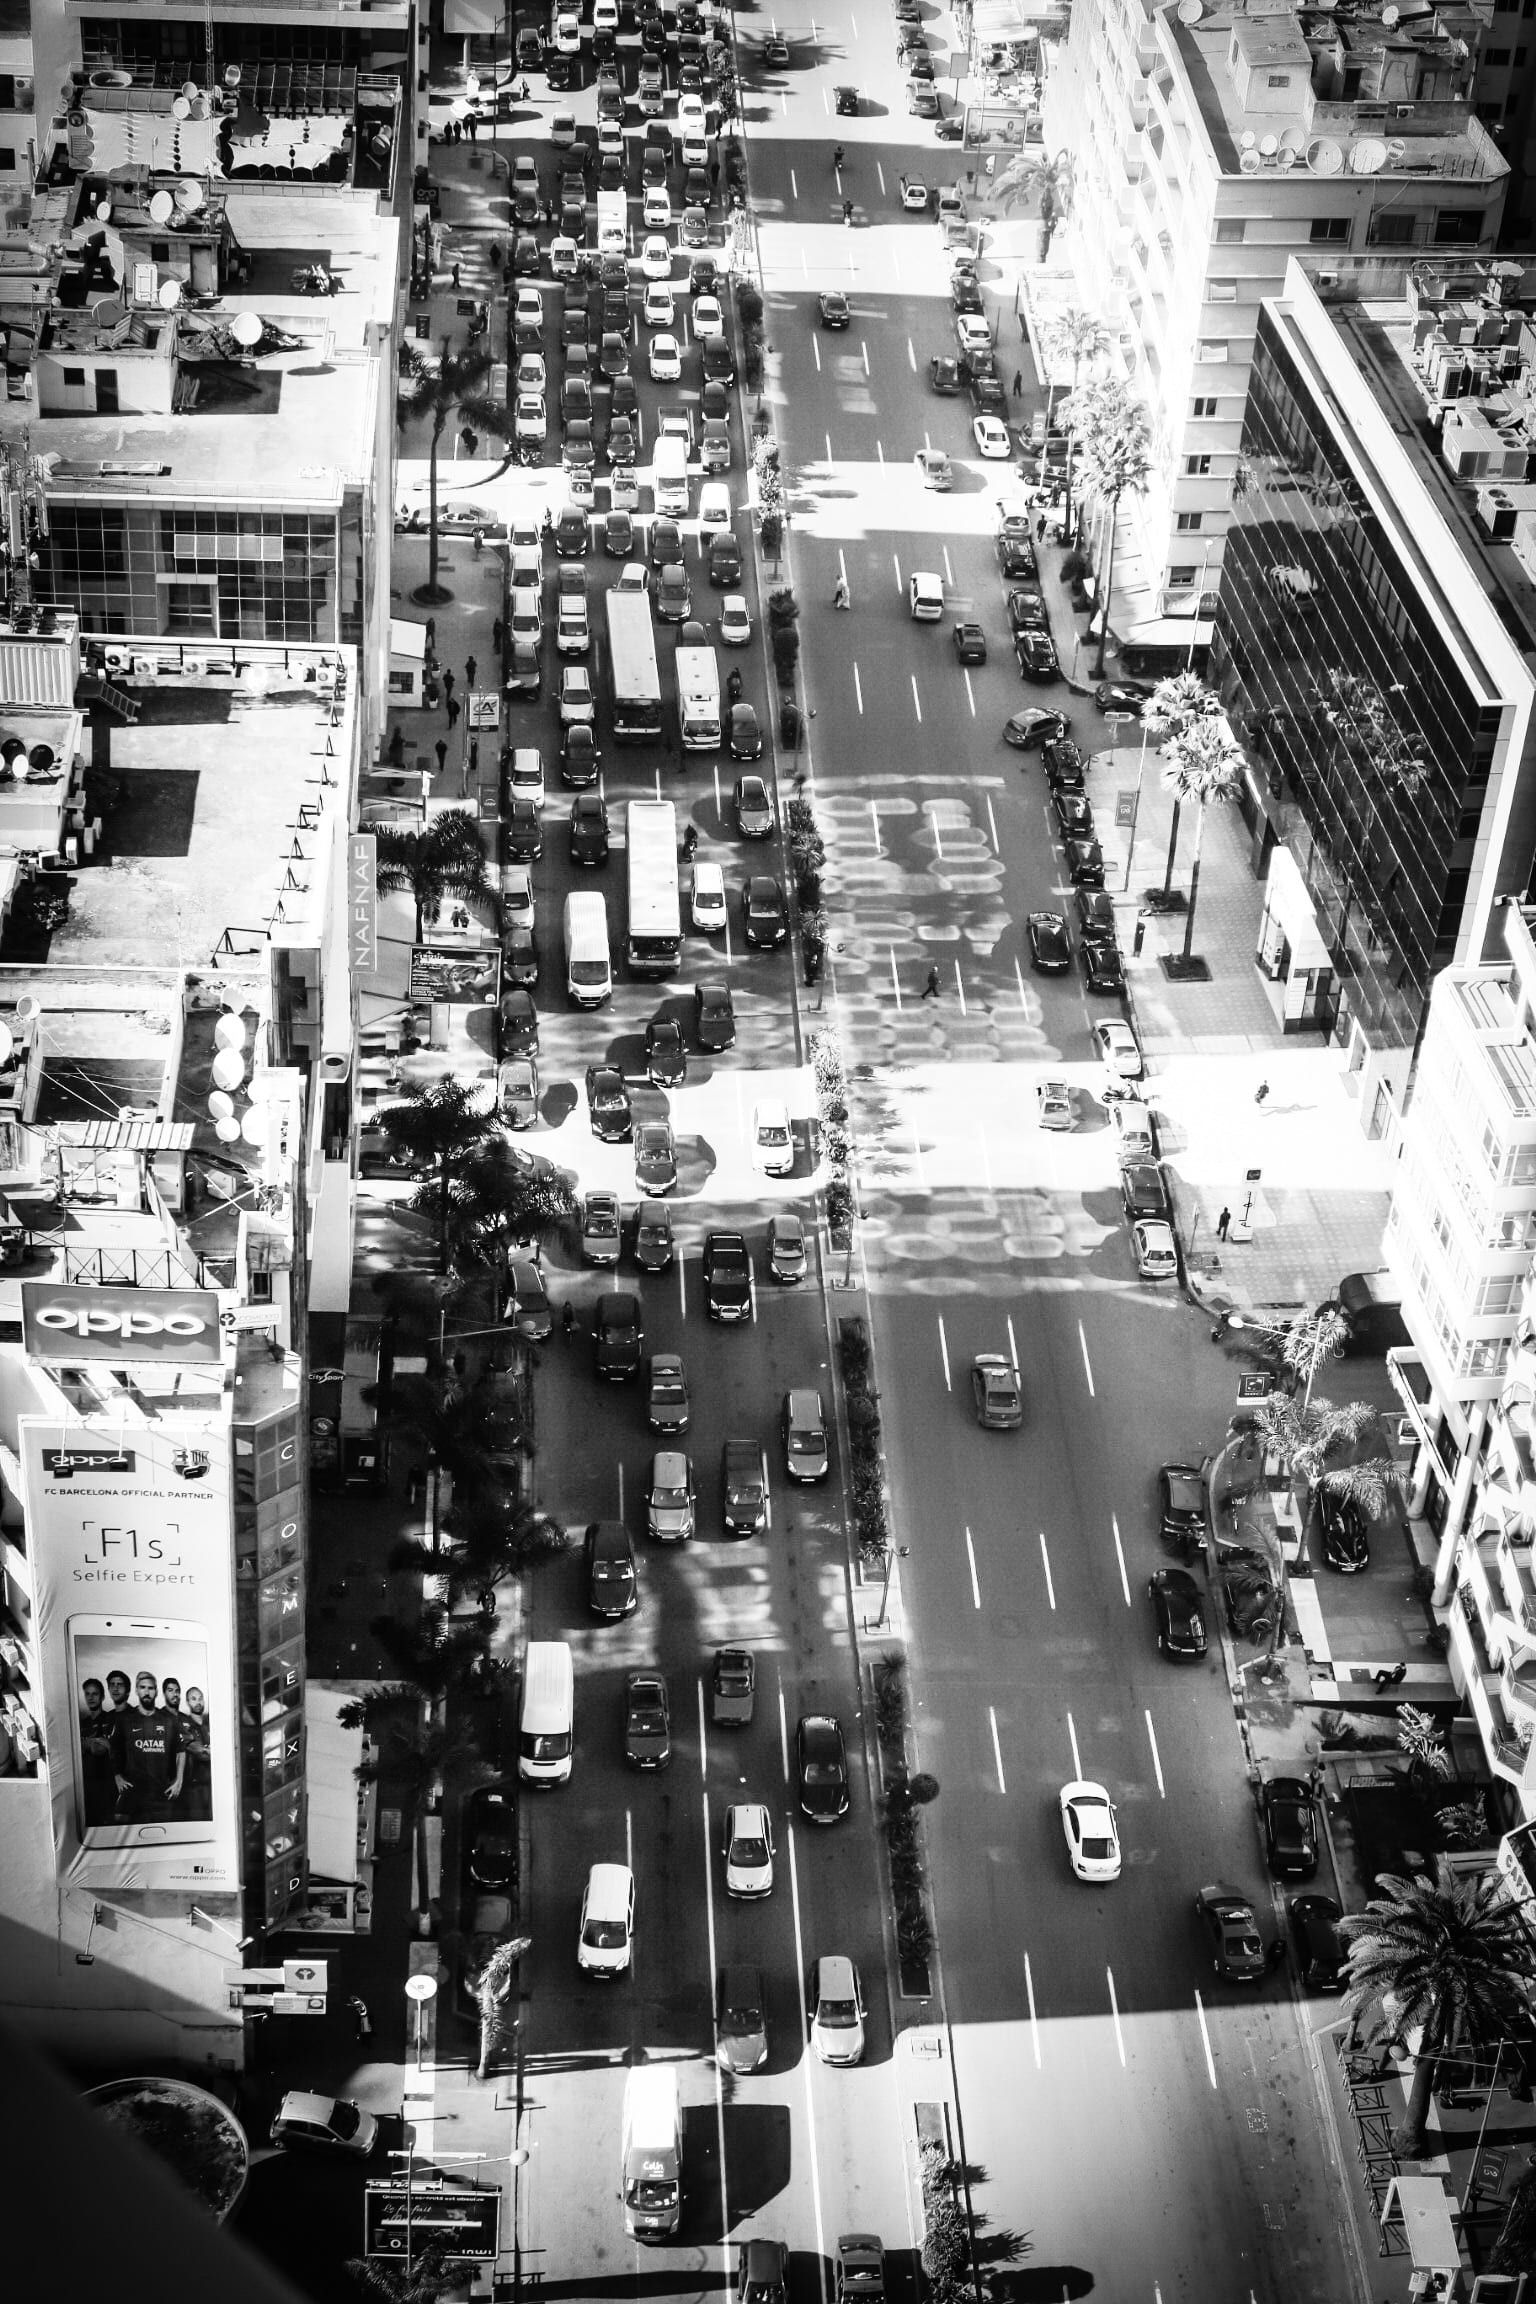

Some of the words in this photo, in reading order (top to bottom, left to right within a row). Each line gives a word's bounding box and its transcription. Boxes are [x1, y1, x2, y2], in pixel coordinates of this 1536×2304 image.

[354, 843, 371, 967] NAFNAF
[35, 1306, 206, 1338] oppo
[59, 1488, 119, 1496] BARCELONA
[121, 1489, 164, 1498] OFFICIAL
[167, 1491, 214, 1500] PARTNER
[101, 1528, 163, 1559] F1s
[73, 1569, 127, 1582] Selfie
[133, 1570, 195, 1585] Expert
[135, 1739, 165, 1749] QATAR
